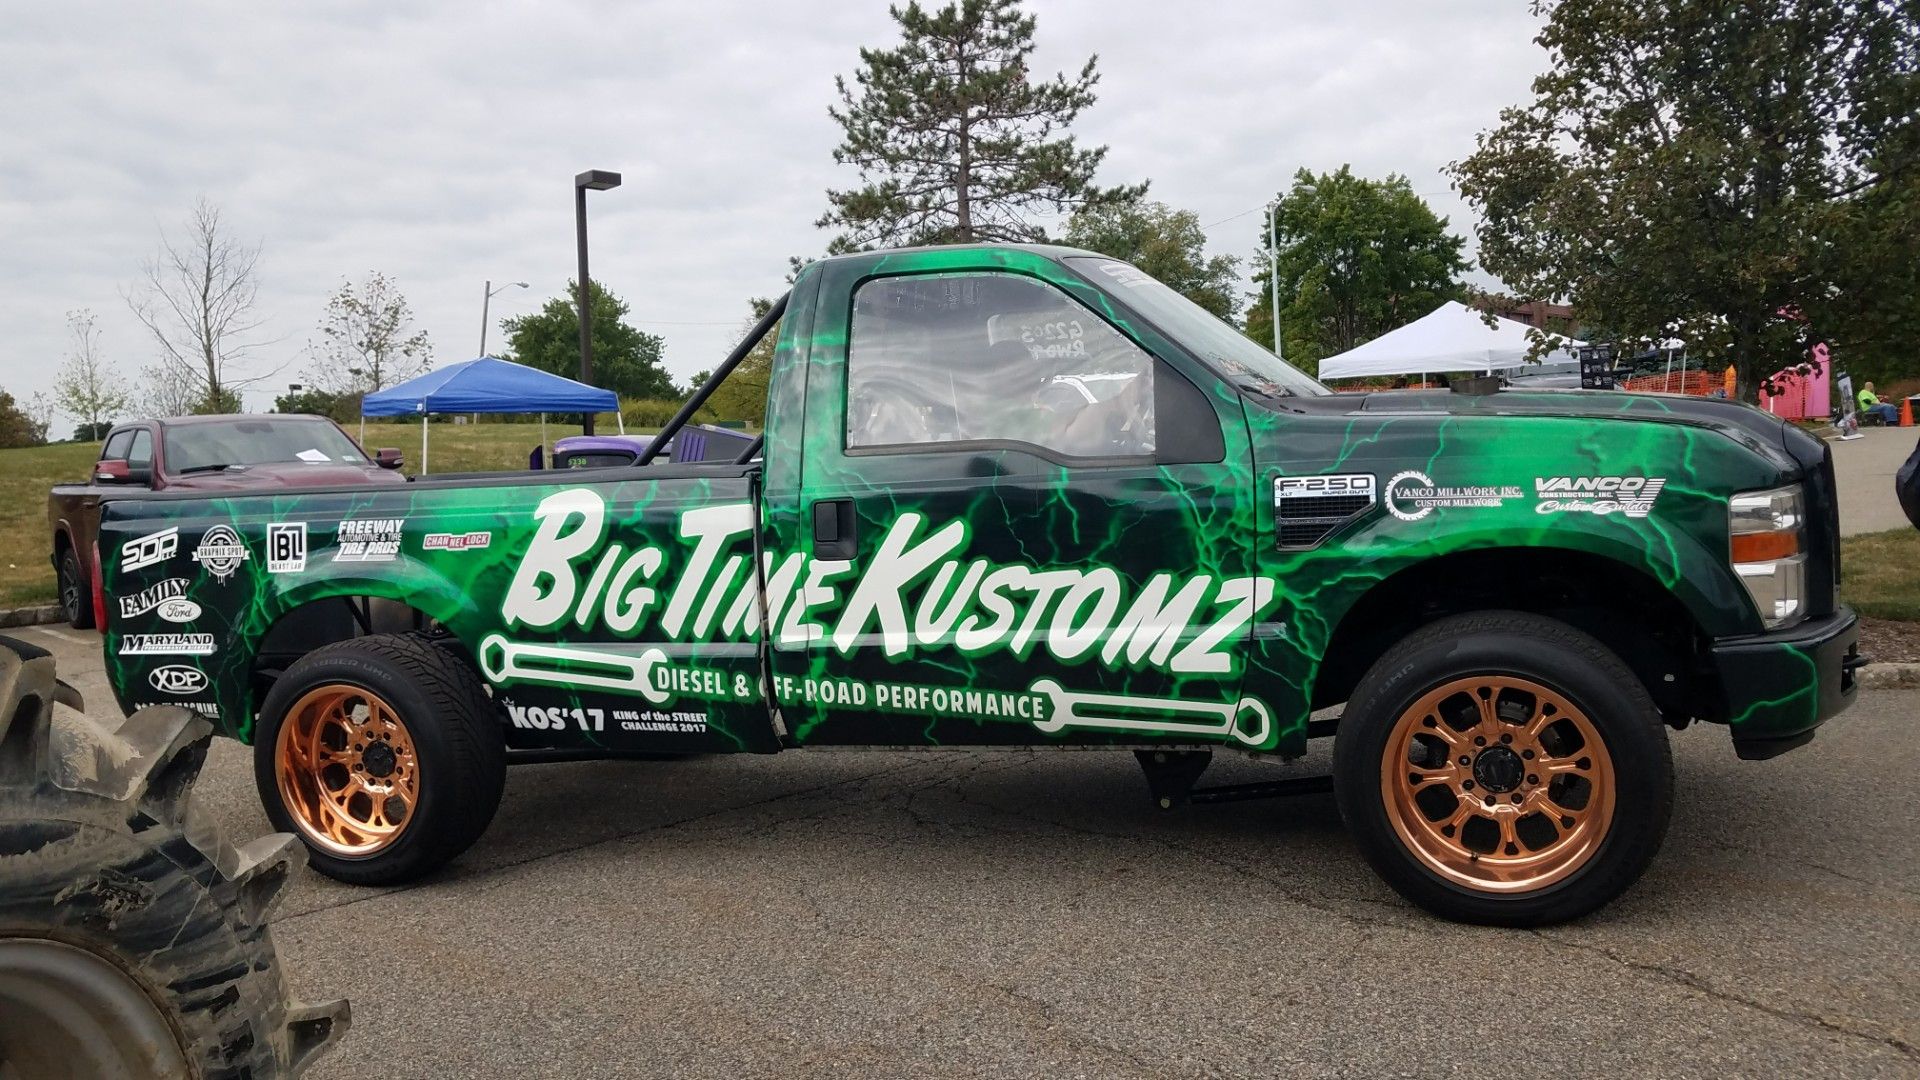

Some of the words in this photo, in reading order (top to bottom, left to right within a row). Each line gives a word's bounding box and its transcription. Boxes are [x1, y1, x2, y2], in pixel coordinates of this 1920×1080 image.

[1280, 477, 1370, 492] F-250
[1395, 487, 1434, 497] VANCO
[1437, 486, 1498, 497] MILLWORK
[1535, 477, 1646, 491] VANCO
[1415, 499, 1450, 507] CUSTOM
[1452, 498, 1502, 507] MILLWORK
[338, 519, 404, 534] FREEWAY
[337, 533, 379, 543] AUTOMOTIVE
[388, 533, 402, 542] TIRE
[121, 578, 189, 617] FAMILY
[166, 602, 193, 618] Ford
[123, 634, 213, 652] MARYLAND
[153, 668, 202, 691] XDP
[657, 666, 726, 695] DIESEL
[734, 674, 750, 697] &
[875, 684, 1044, 719] PERFORMANCE
[508, 706, 604, 731] KOS'17
[612, 710, 639, 720] KING
[640, 711, 651, 721] of
[652, 711, 671, 721] the
[671, 712, 707, 723] STREET
[621, 721, 679, 732] CHALLENGE
[680, 723, 706, 733] 2017
